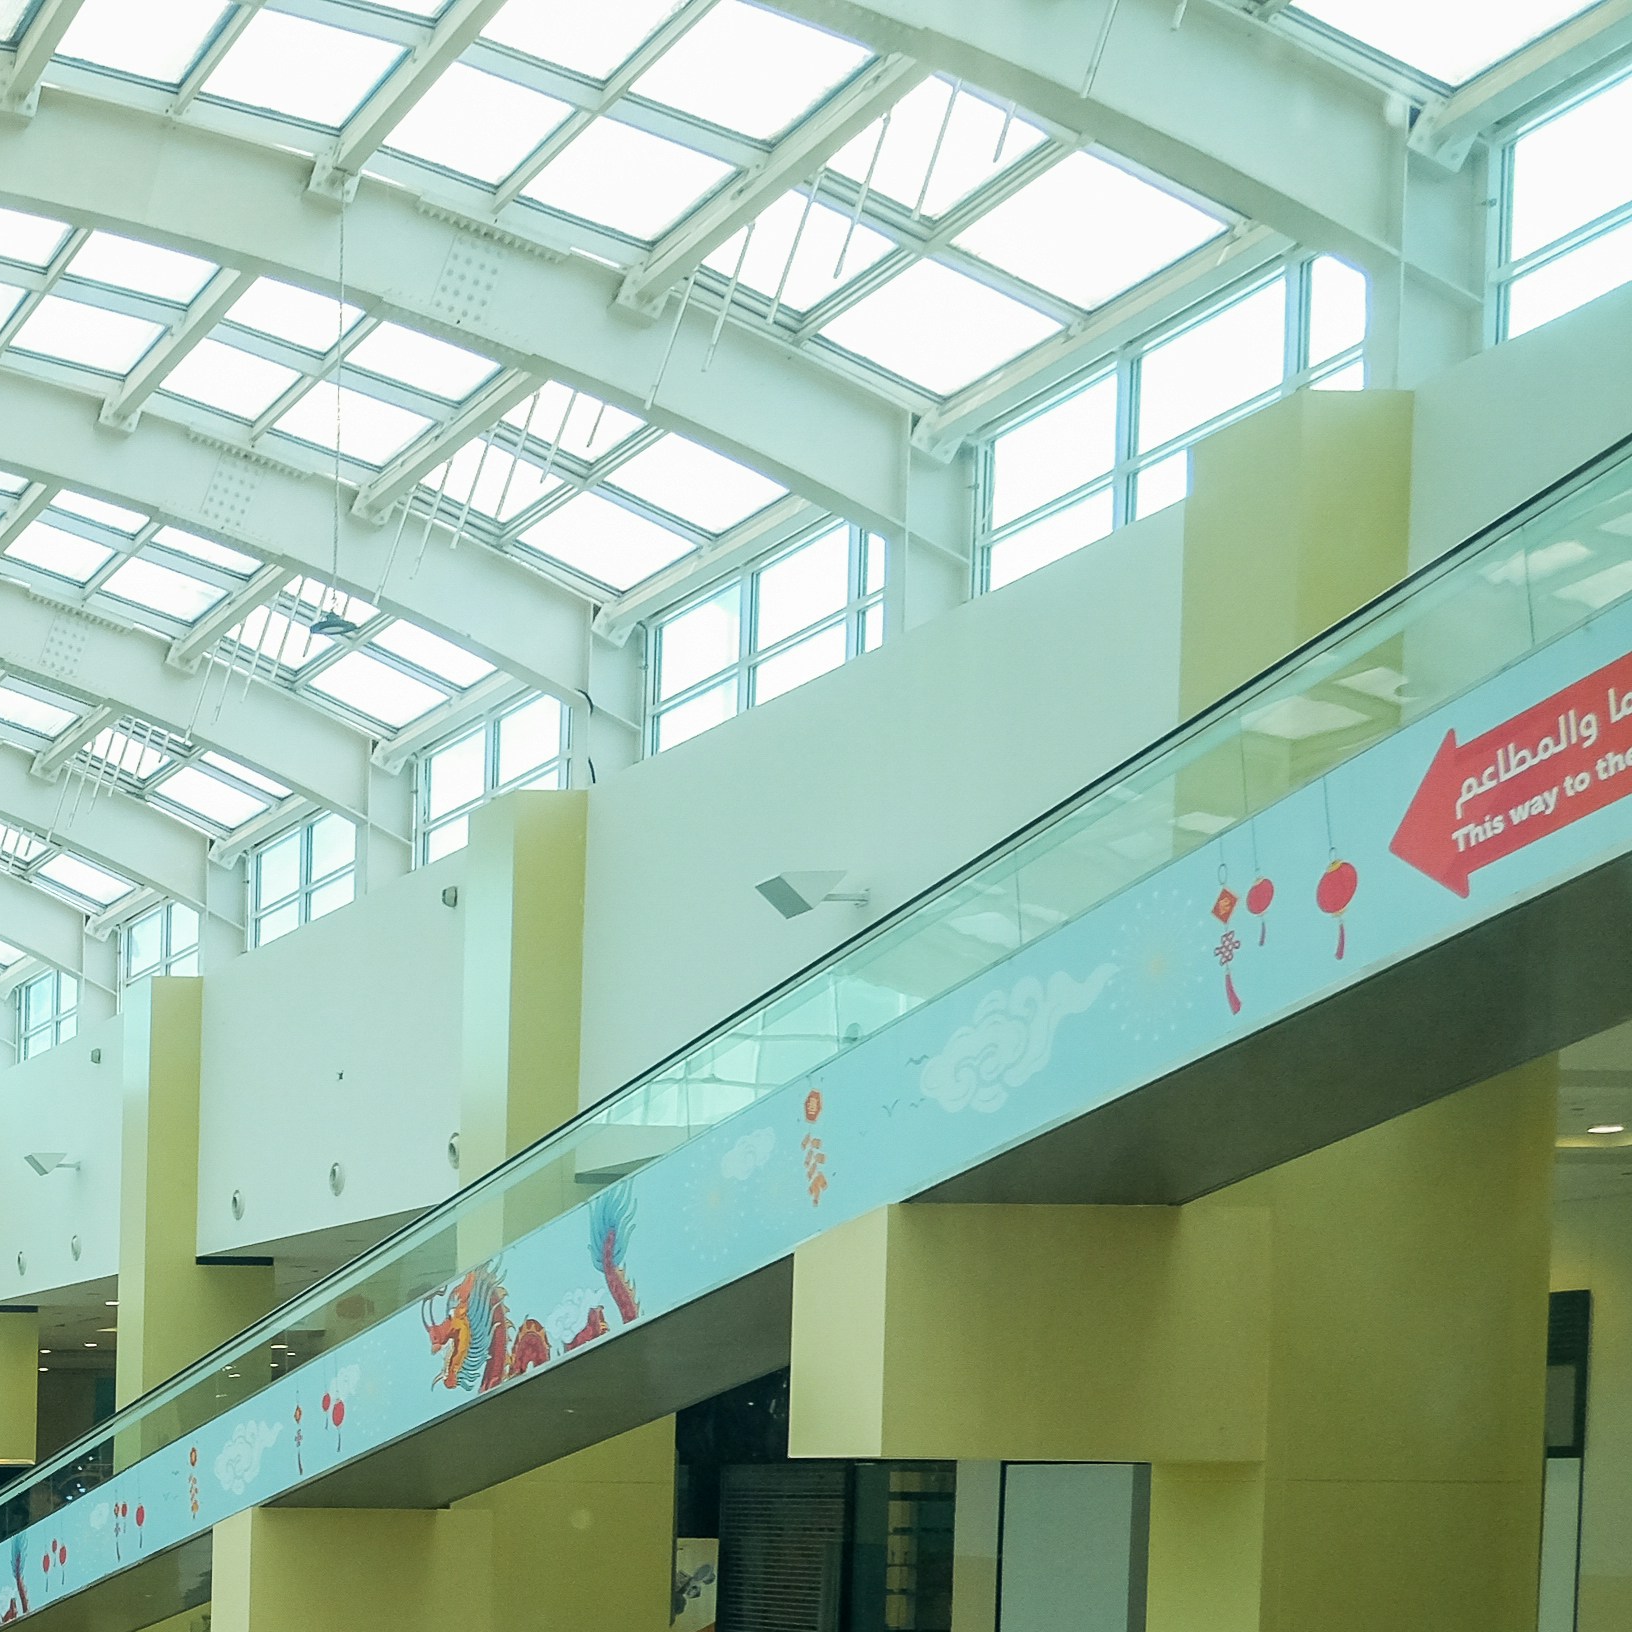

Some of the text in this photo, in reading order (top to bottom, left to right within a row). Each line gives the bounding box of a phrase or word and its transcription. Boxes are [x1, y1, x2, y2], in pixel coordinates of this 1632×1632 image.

[1455, 709, 1598, 819] والمطاعم
[1451, 816, 1504, 852] This
[1509, 786, 1559, 824] way
[1563, 772, 1591, 797] to
